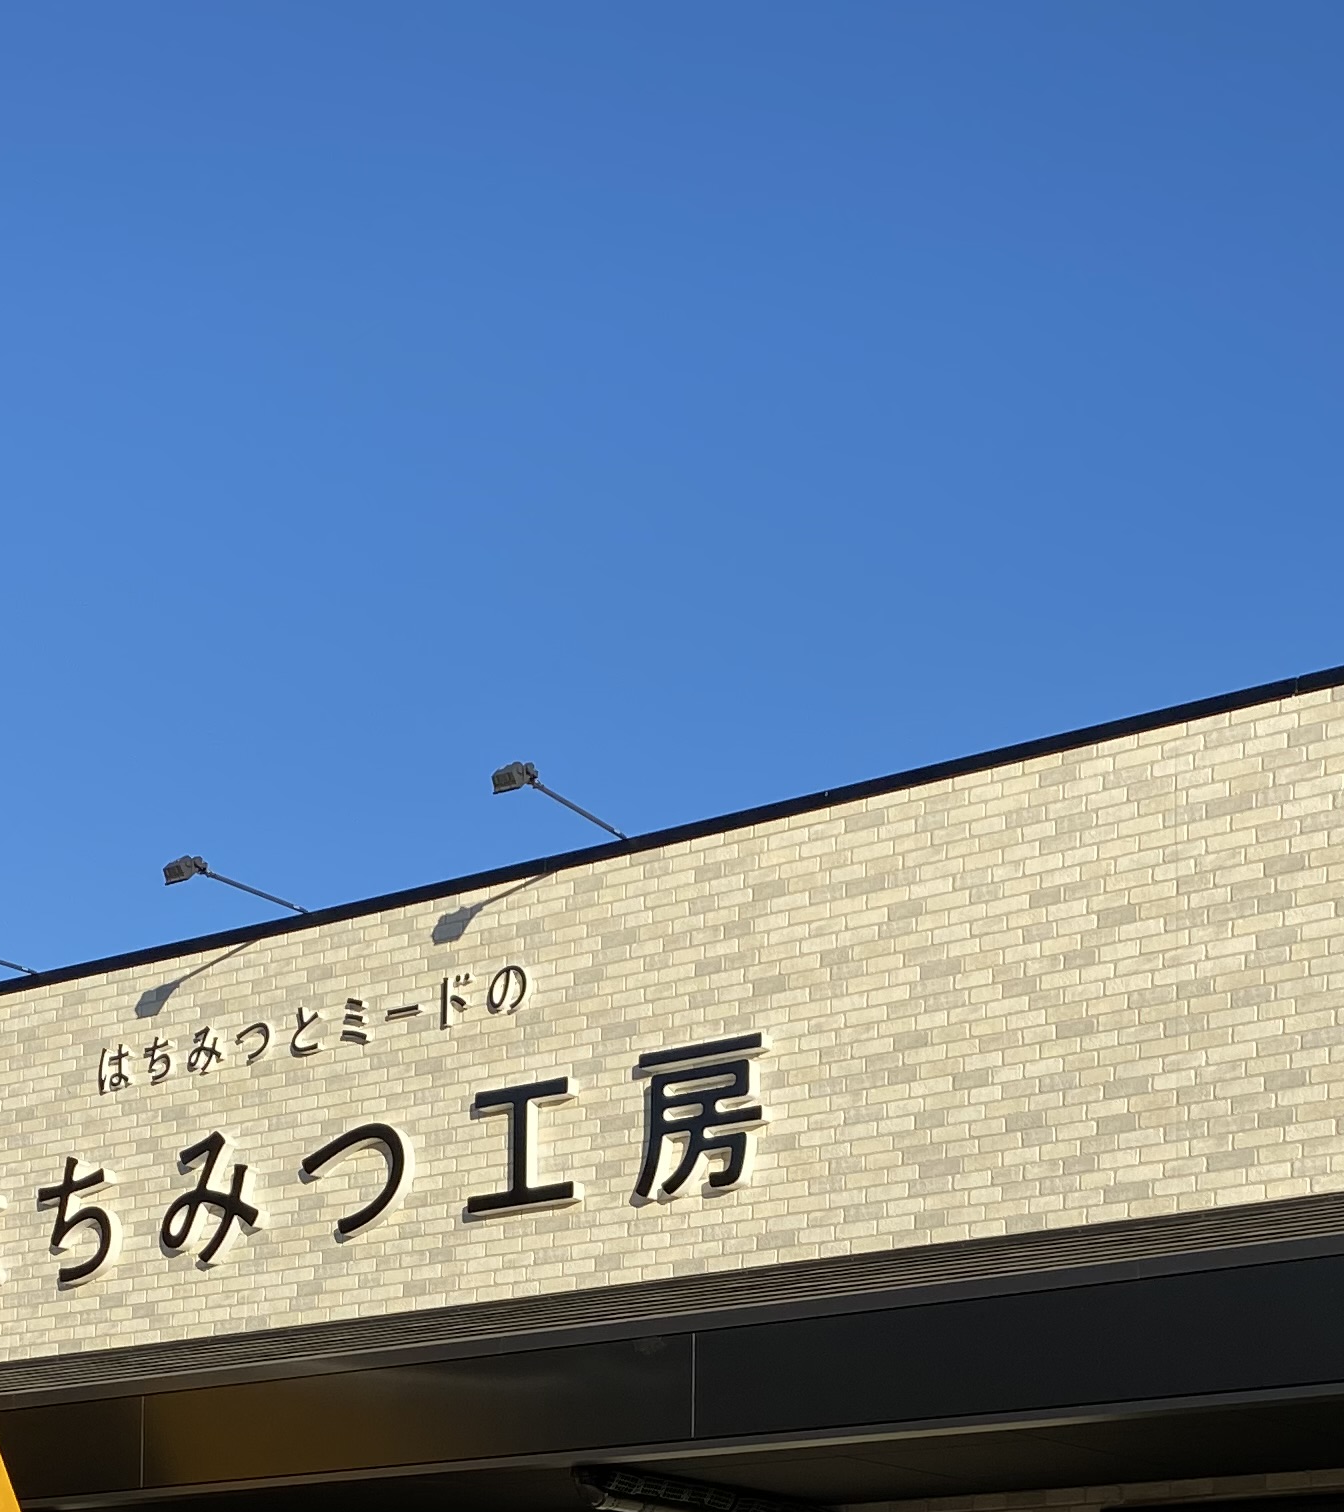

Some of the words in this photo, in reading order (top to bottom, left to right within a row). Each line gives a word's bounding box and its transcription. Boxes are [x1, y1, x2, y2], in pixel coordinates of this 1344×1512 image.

[98, 965, 528, 1095] はちみつとミードの
